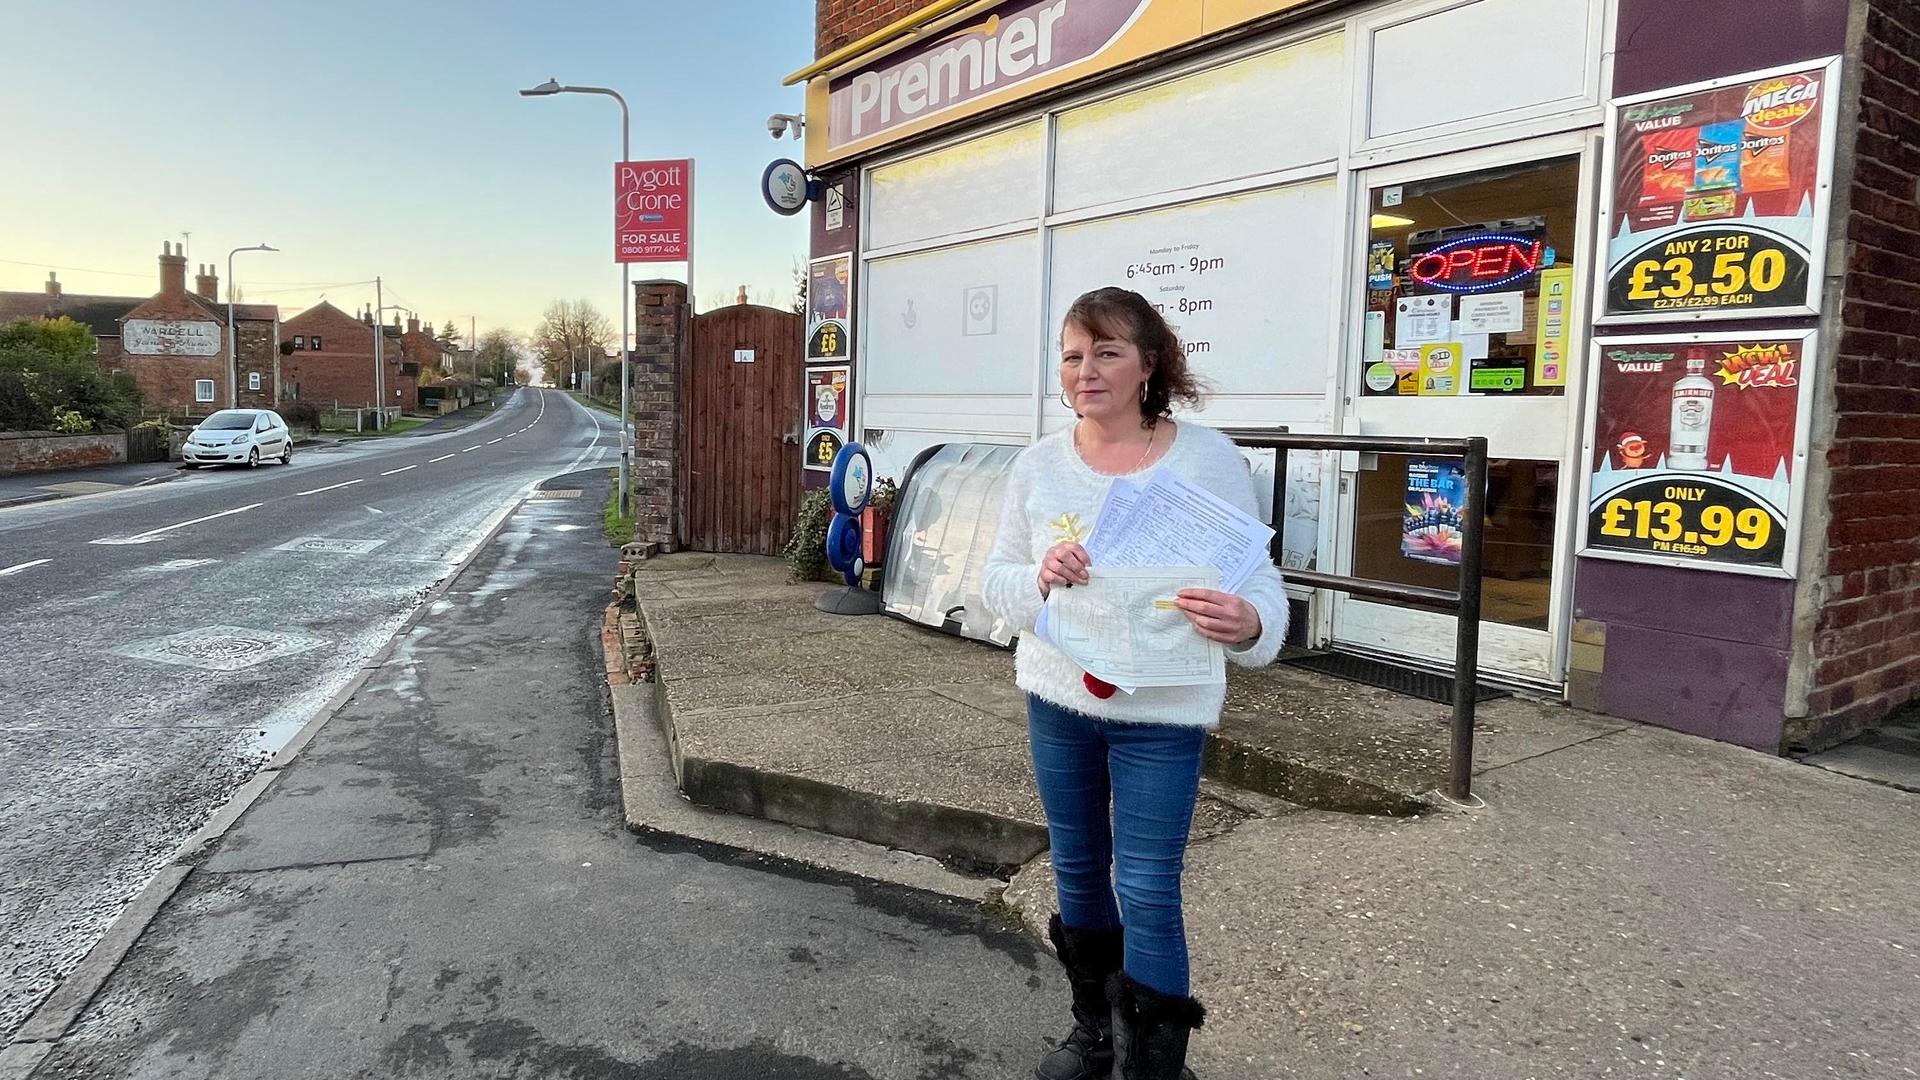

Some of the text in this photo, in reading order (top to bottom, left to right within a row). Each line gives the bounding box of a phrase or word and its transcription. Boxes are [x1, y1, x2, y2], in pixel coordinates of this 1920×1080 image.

[851, 0, 1067, 136] Premier
[1741, 80, 1820, 118] MEGA
[1752, 102, 1808, 123] deals
[1635, 116, 1682, 132] VALUE
[1648, 149, 1693, 165] Doritos
[622, 166, 681, 192] Pygott
[626, 191, 681, 211] Crone
[622, 233, 681, 244] FOR SALE
[1665, 235, 1749, 256] ANY 2 FOR
[622, 245, 680, 254] 0800 9177 404
[1150, 247, 1172, 255] Monday
[1126, 262, 1175, 279] 6:45am
[1189, 256, 1224, 275] 9pm
[1411, 241, 1541, 282] OPEN
[1369, 273, 1392, 282] PUSH
[1627, 249, 1786, 300] £3.50
[1178, 298, 1212, 316] 8pm
[1654, 293, 1753, 309] £2.75/£2.99 EACH
[143, 327, 203, 337] WARDELL
[821, 333, 836, 353] £6
[1617, 362, 1663, 372] VALUE
[1739, 361, 1797, 387] DEAL
[818, 442, 833, 461] £5
[1408, 478, 1454, 490] THE BAR
[1664, 486, 1706, 501] ONLY
[1600, 498, 1771, 550] £13.99
[1653, 540, 1670, 551] PM
